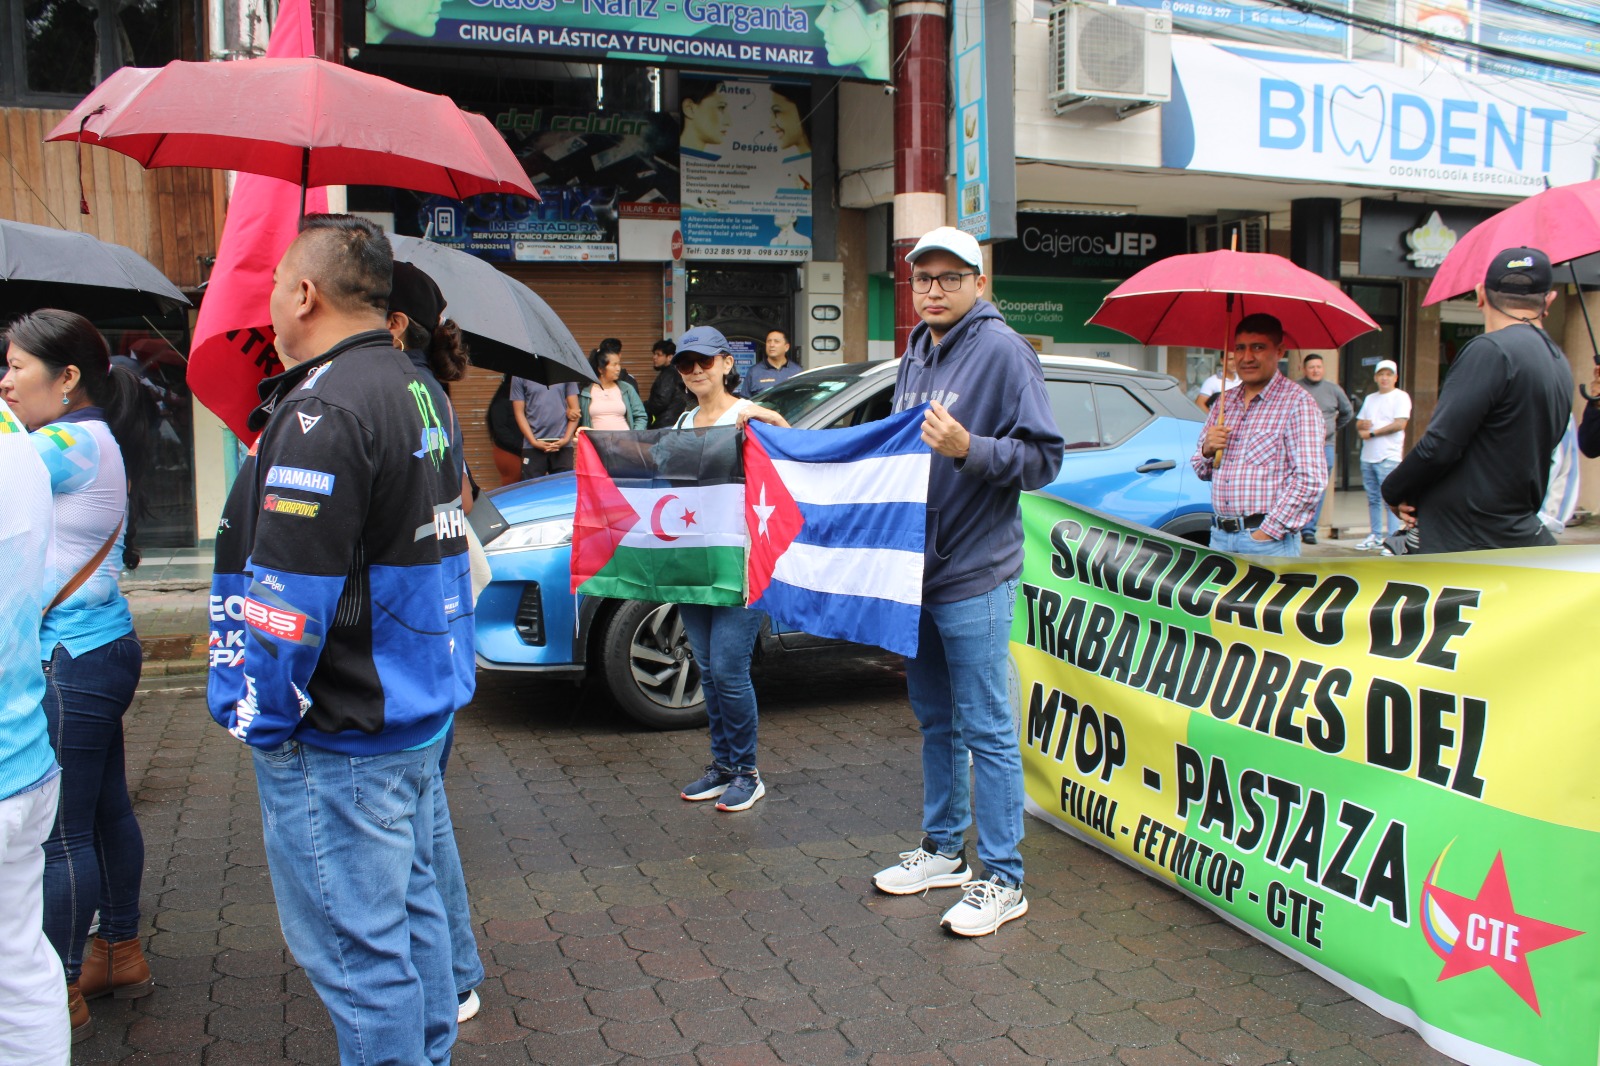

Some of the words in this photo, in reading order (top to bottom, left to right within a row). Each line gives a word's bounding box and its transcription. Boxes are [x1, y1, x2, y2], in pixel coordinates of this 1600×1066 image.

[683, 0, 809, 34] Garganta
[1173, 3, 1194, 13] 0998
[1214, 7, 1232, 18] 297
[459, 23, 534, 43] CIRUGÍA
[539, 28, 621, 49] PLÁSTICA
[623, 36, 636, 50] Y
[639, 36, 736, 59] FUNCIONAL
[740, 45, 762, 61] DE
[766, 47, 814, 64] NARIZ
[719, 84, 751, 95] Antes
[496, 108, 542, 132] del
[551, 113, 649, 135] celular
[732, 141, 778, 154] Después
[1389, 165, 1469, 181] ODONTOLOGÍA
[473, 232, 509, 240] SERVICIO
[543, 233, 603, 241] ESPECIALIZADO
[490, 222, 601, 232] IMPORTADORA
[999, 299, 1064, 313] Cooperativa
[1028, 314, 1033, 324] y
[1035, 312, 1064, 322] Crédito
[279, 469, 330, 491] YAMAHA
[1050, 519, 1359, 646] SINDICATO
[1369, 580, 1483, 671] DE
[245, 601, 296, 632] BS
[1022, 582, 1353, 755] TRABAJADORES
[1365, 676, 1487, 800] DEL
[1027, 681, 1126, 783] MTOP
[1175, 741, 1410, 928] PASTAZA
[1060, 777, 1117, 841] FILIAL
[1132, 814, 1245, 905] FETMTOP
[1266, 881, 1325, 950] CTE
[1466, 913, 1520, 963] CTE
